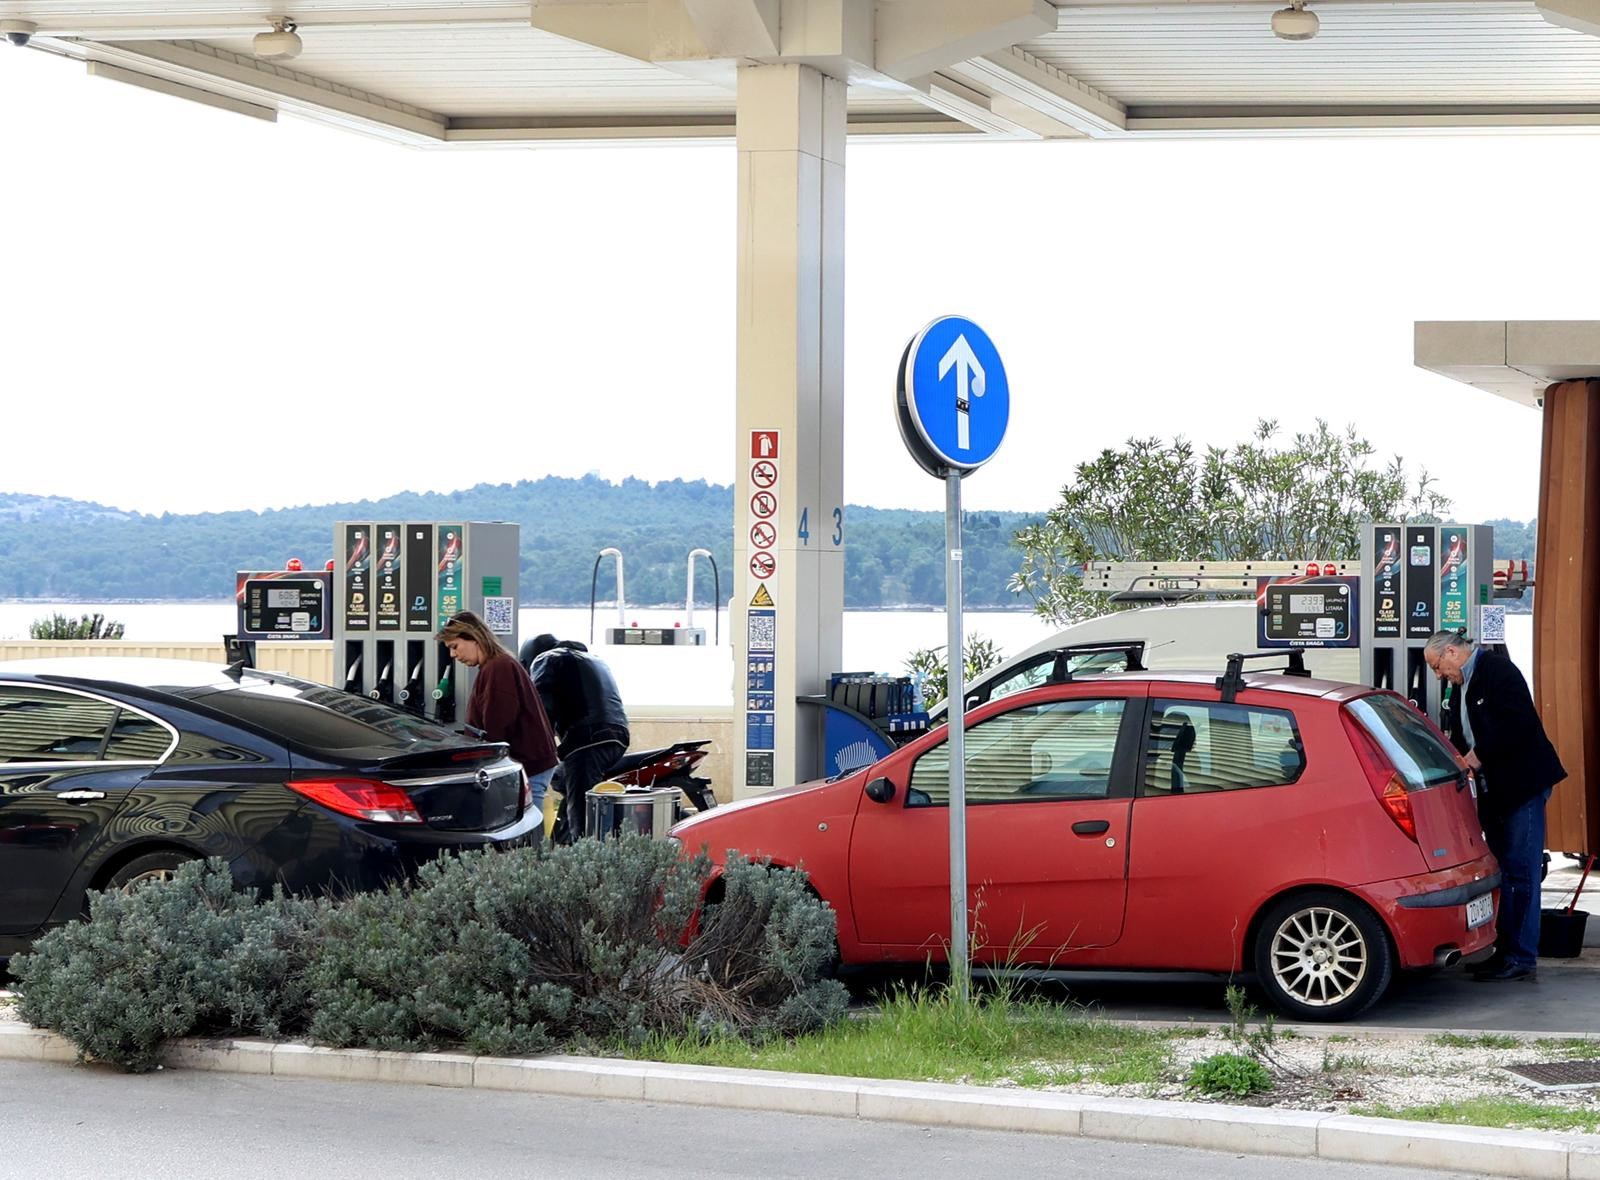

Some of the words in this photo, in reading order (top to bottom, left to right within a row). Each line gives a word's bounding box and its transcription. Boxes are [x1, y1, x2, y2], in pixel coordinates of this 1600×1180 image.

[798, 507, 809, 546] 4
[832, 507, 843, 546] 3
[352, 592, 364, 604] D
[382, 592, 394, 604] D
[414, 596, 425, 606] D
[442, 595, 457, 604] 95
[1381, 598, 1394, 609] D
[1415, 601, 1426, 611] D
[1446, 601, 1461, 611] 95
[310, 615, 318, 628] 4
[1336, 621, 1344, 634] 2
